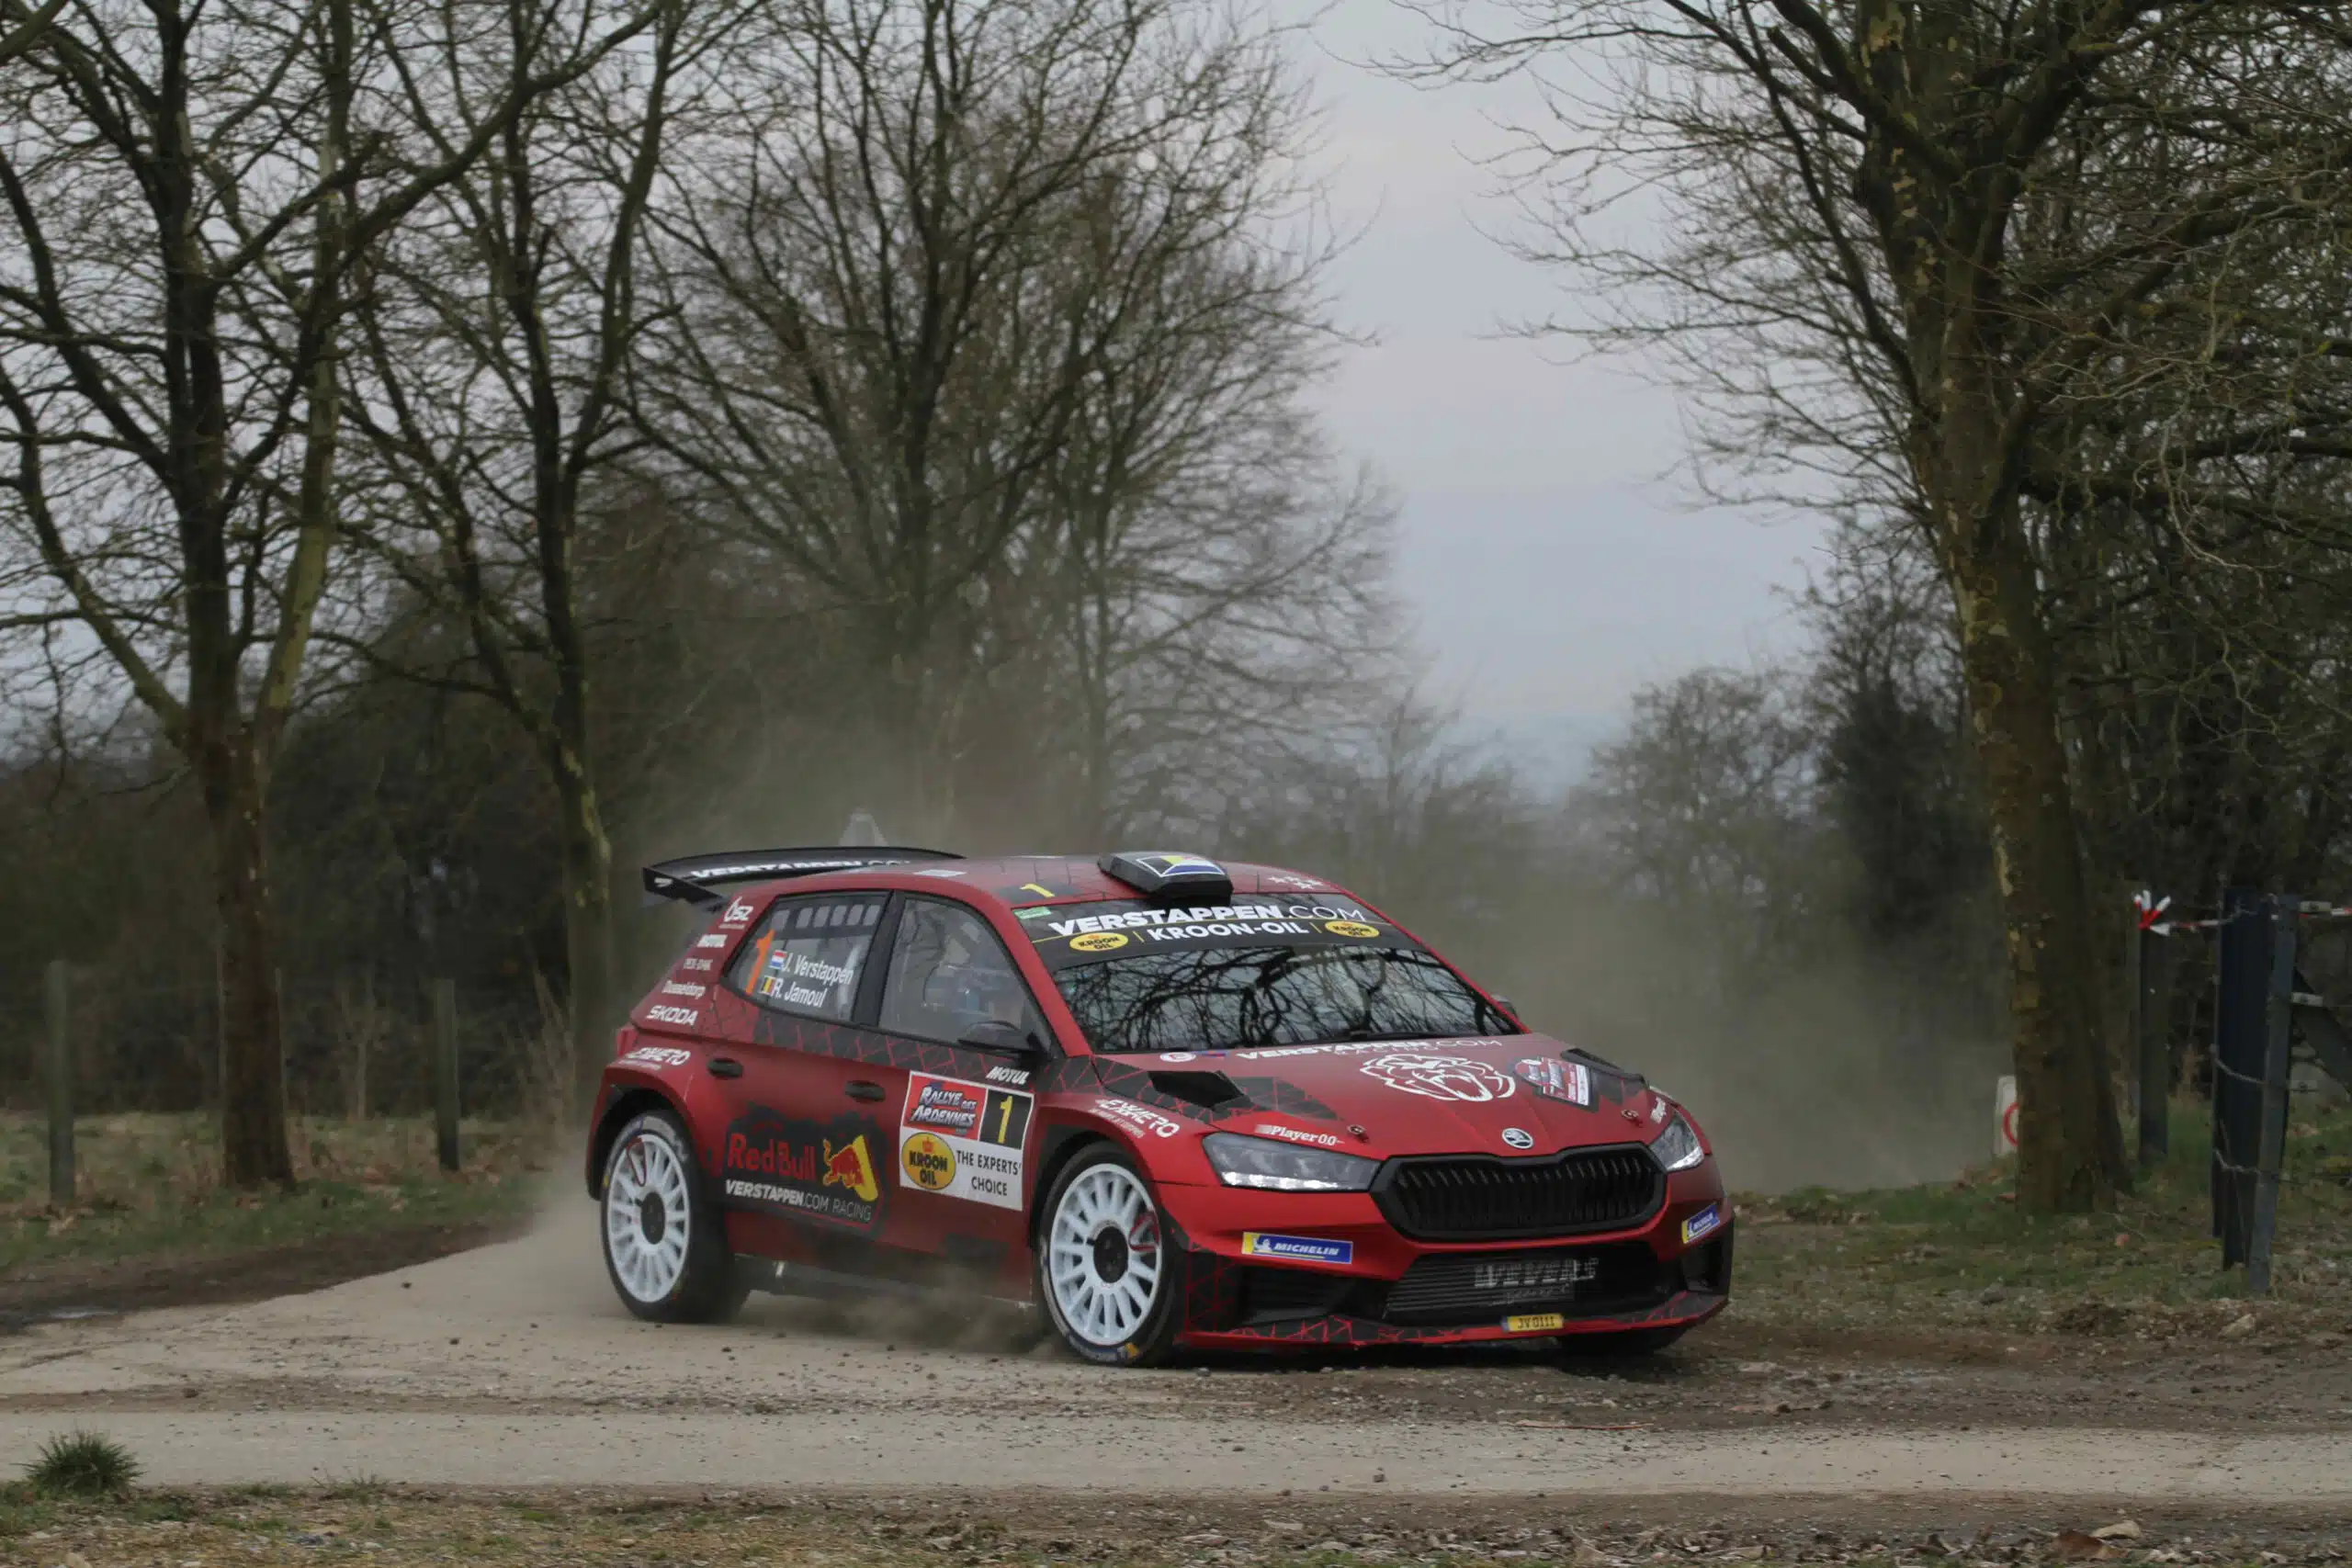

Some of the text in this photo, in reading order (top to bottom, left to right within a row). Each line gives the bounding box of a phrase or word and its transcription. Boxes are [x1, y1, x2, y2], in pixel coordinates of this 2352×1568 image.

[1048, 905, 1366, 936] VERSTAPPEN.COM
[1147, 921, 1309, 942] KROON-OIL
[745, 929, 775, 995] 1
[781, 952, 854, 986] J. Verstappen
[771, 977, 828, 1008] R. Jamoul
[985, 1066, 1030, 1085] MOTUL
[920, 1086, 963, 1105] RALLYE
[910, 1105, 977, 1126] ARDENNES
[997, 1095, 1012, 1144] 1
[727, 1133, 817, 1180] Red Bull
[909, 1150, 948, 1172] KROON
[956, 1150, 974, 1167] THE
[919, 1170, 937, 1186] OIL
[971, 1176, 1007, 1196] CHOICE
[725, 1179, 872, 1221] VERSTAPPEN.COM RACING
[1274, 1243, 1340, 1256] MICHELIN
